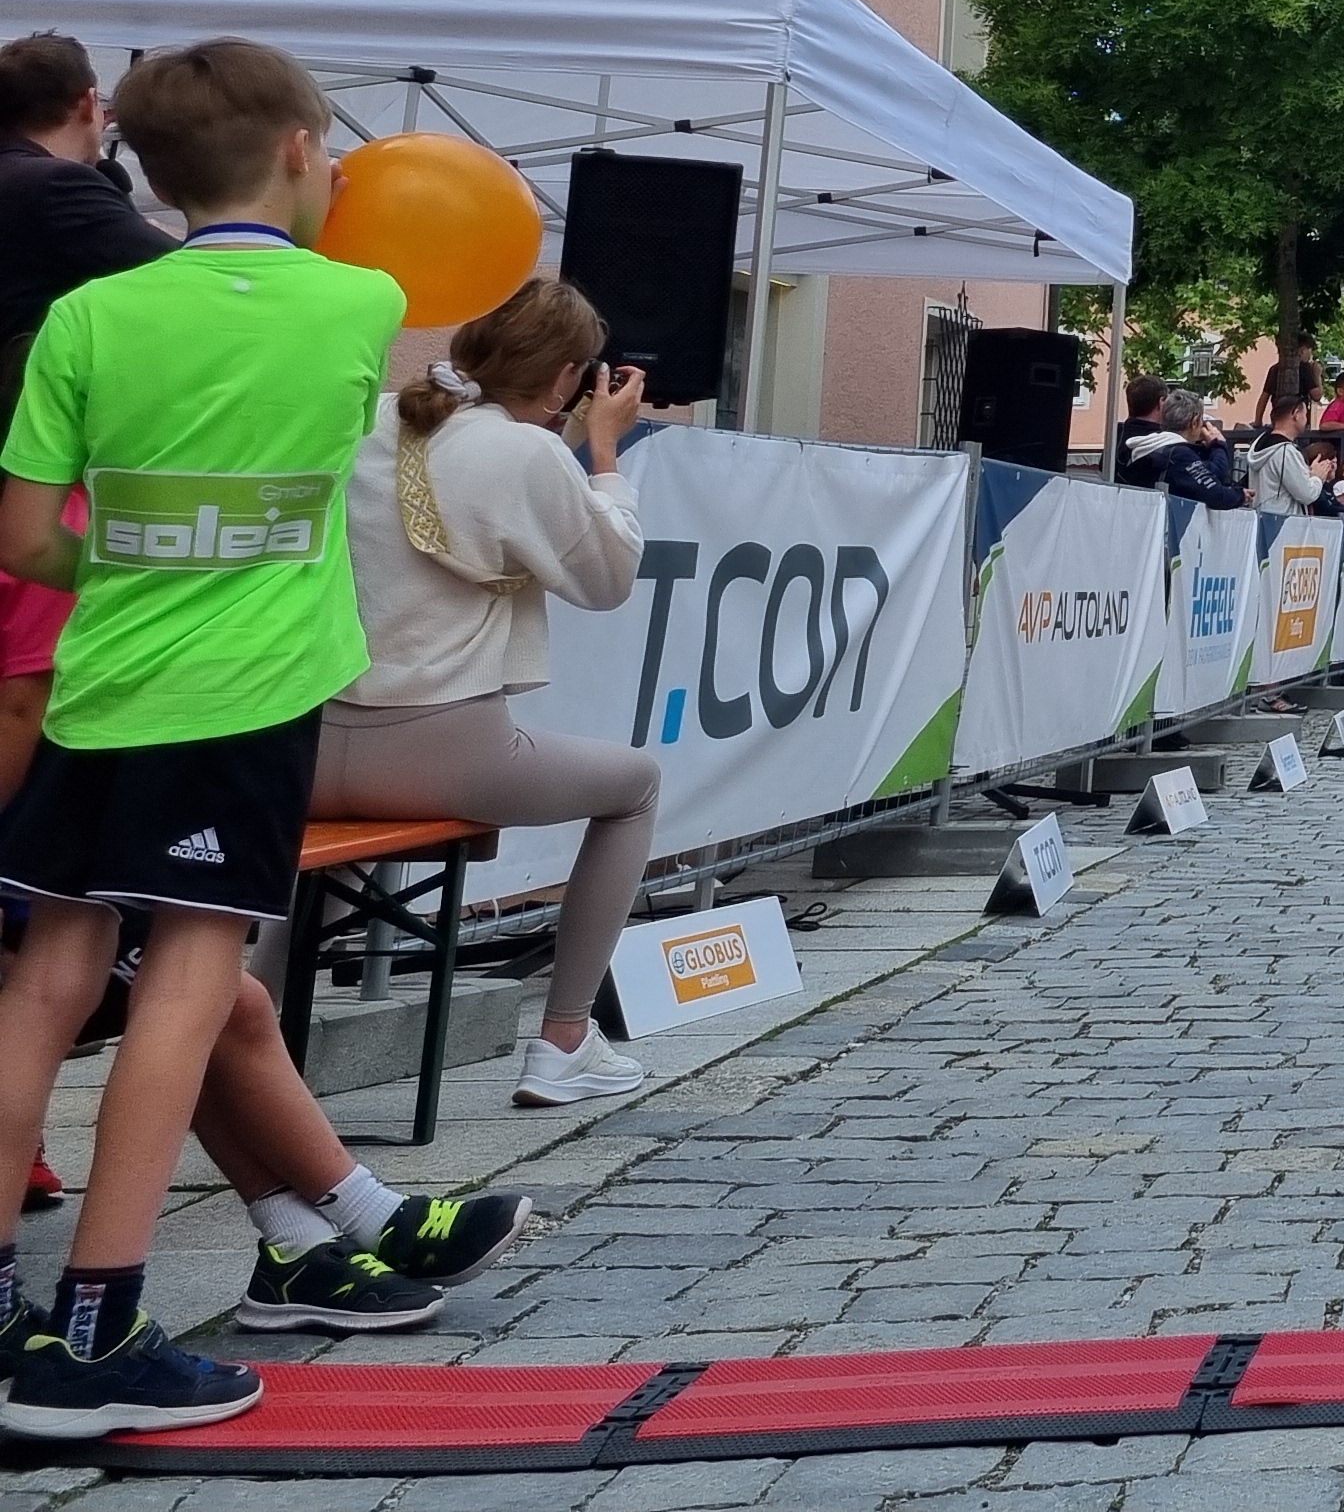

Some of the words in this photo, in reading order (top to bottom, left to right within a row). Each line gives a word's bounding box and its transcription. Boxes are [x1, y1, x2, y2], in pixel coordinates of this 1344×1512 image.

[1017, 591, 1052, 643] AVP
[1051, 590, 1129, 641] AUTOLAND
[168, 845, 226, 864] adidas
[684, 938, 744, 971] GLOBUS
